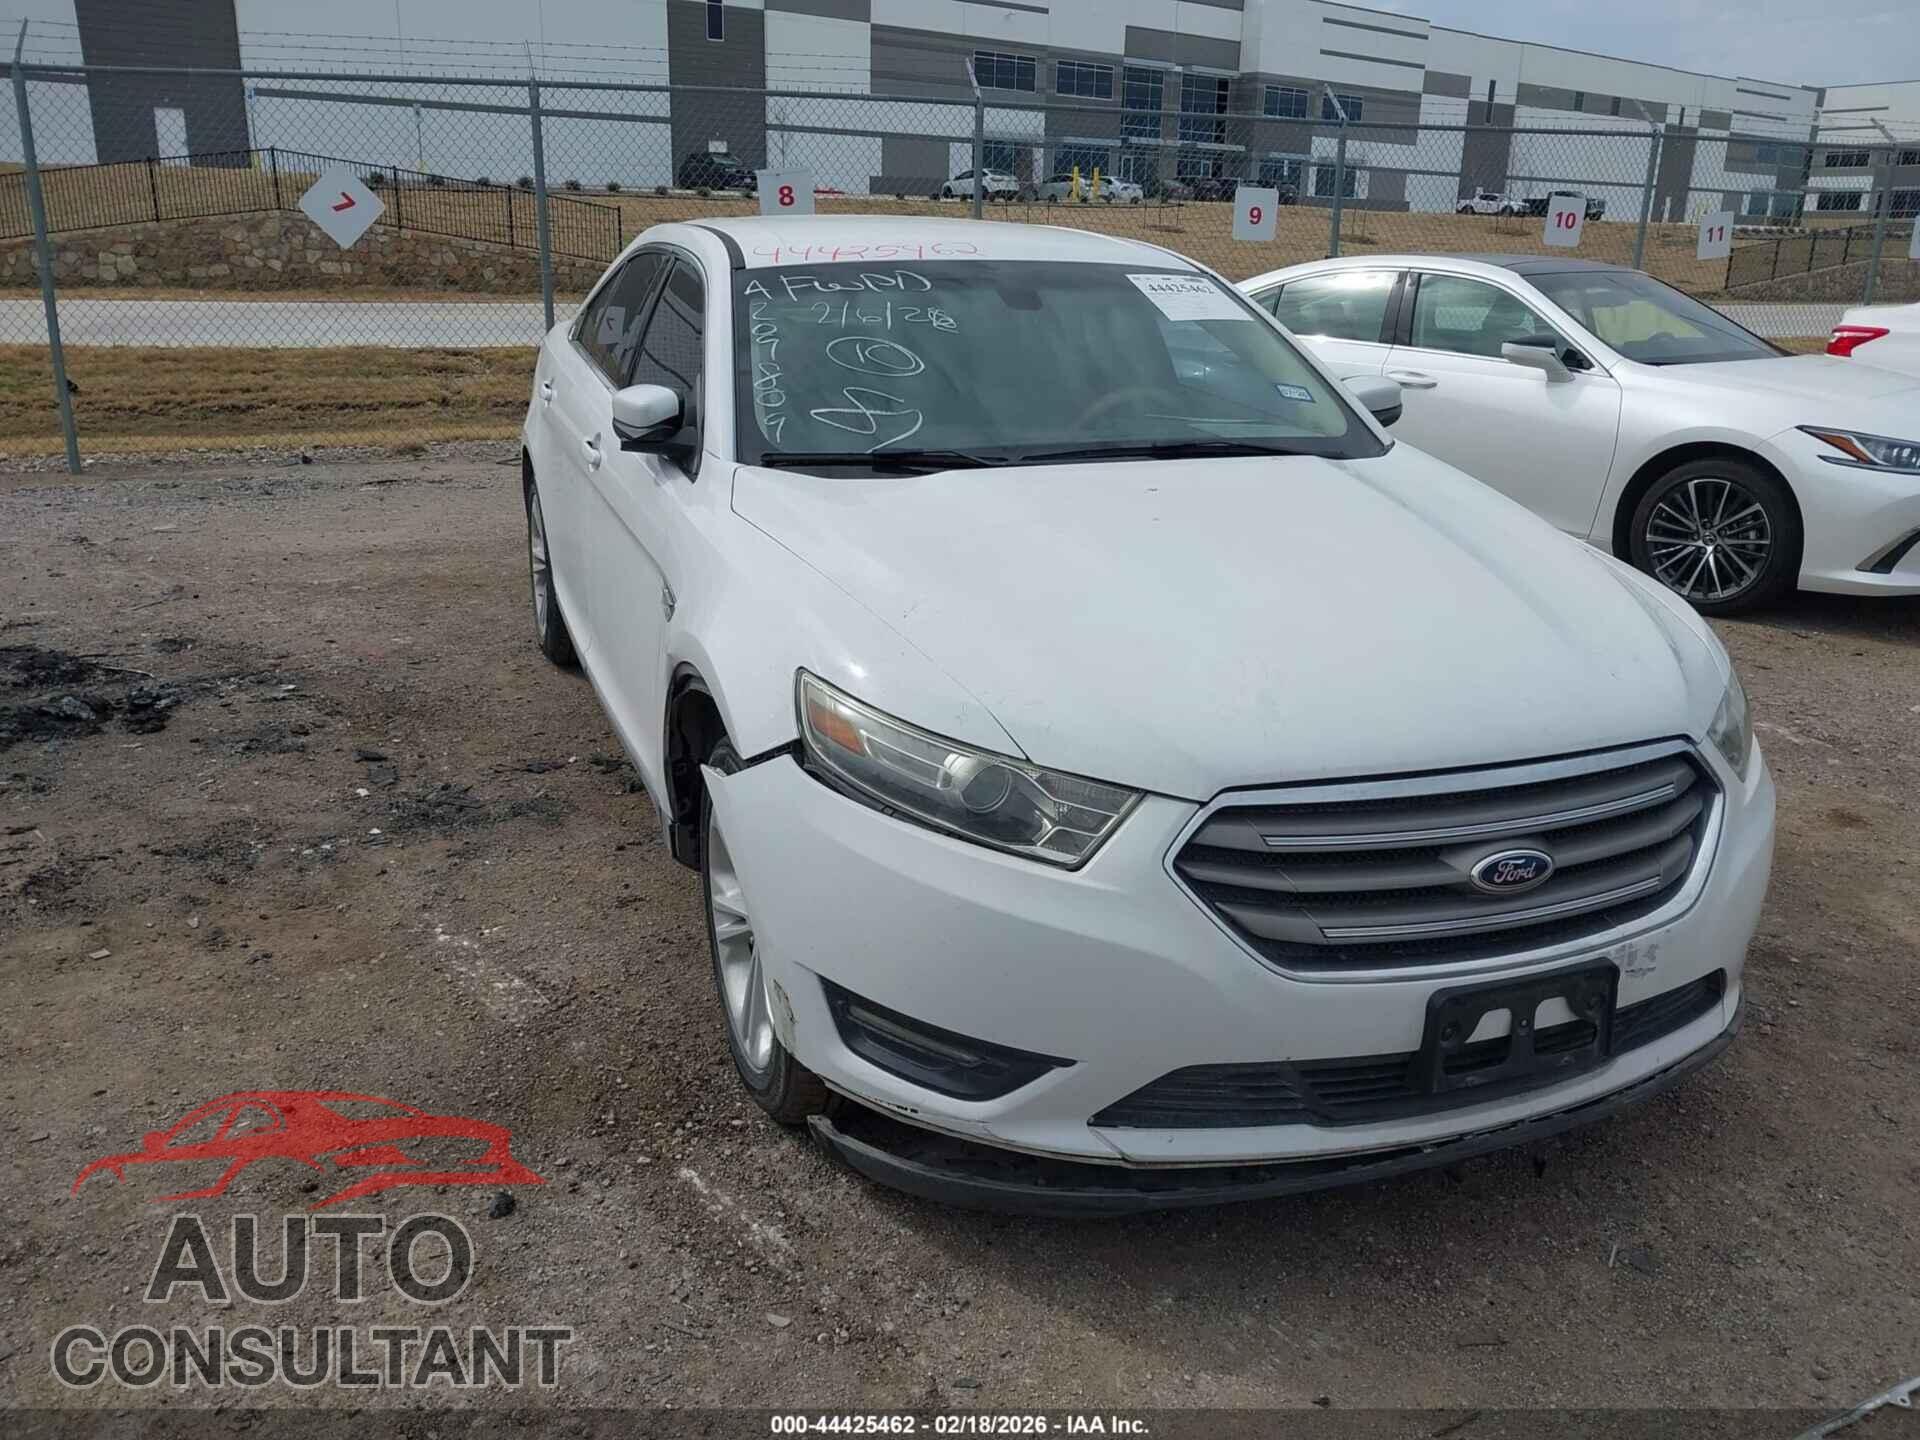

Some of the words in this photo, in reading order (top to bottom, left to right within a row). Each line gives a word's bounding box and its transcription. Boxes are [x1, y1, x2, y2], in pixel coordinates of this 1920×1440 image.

[331, 191, 356, 212] 7
[778, 185, 795, 206] 8
[1249, 206, 1262, 225] 9
[1555, 211, 1576, 229] 10
[1706, 225, 1724, 243] 11
[753, 242, 983, 263] 44425462
[1493, 858, 1537, 883] Ford
